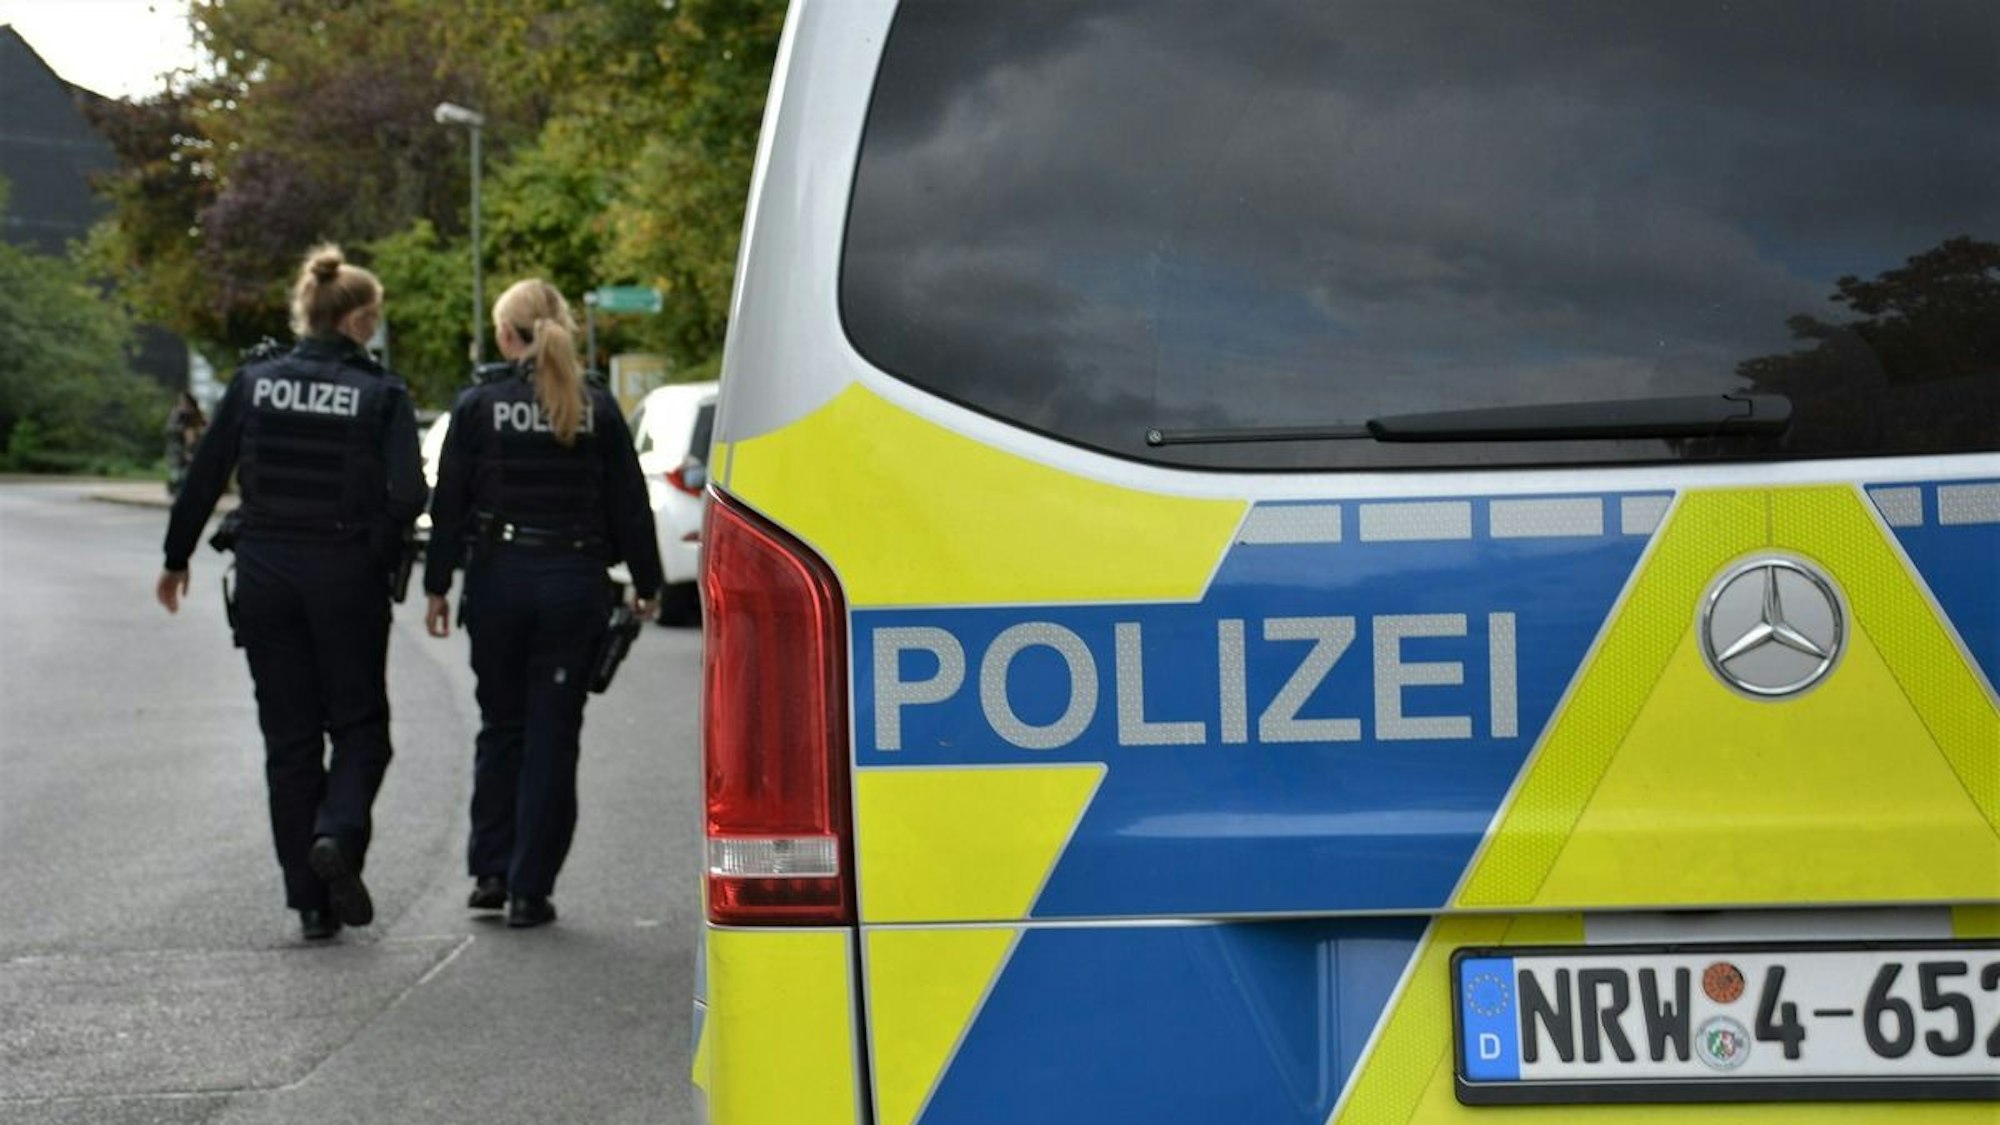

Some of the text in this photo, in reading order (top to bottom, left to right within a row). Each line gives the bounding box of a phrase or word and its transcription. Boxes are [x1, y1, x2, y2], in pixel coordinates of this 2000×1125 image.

[252, 377, 361, 417] POLIZEI
[493, 400, 594, 433] POLI
[872, 612, 1519, 751] POLIZEI
[1518, 966, 1692, 1064] NRW
[1479, 1033, 1501, 1060] D
